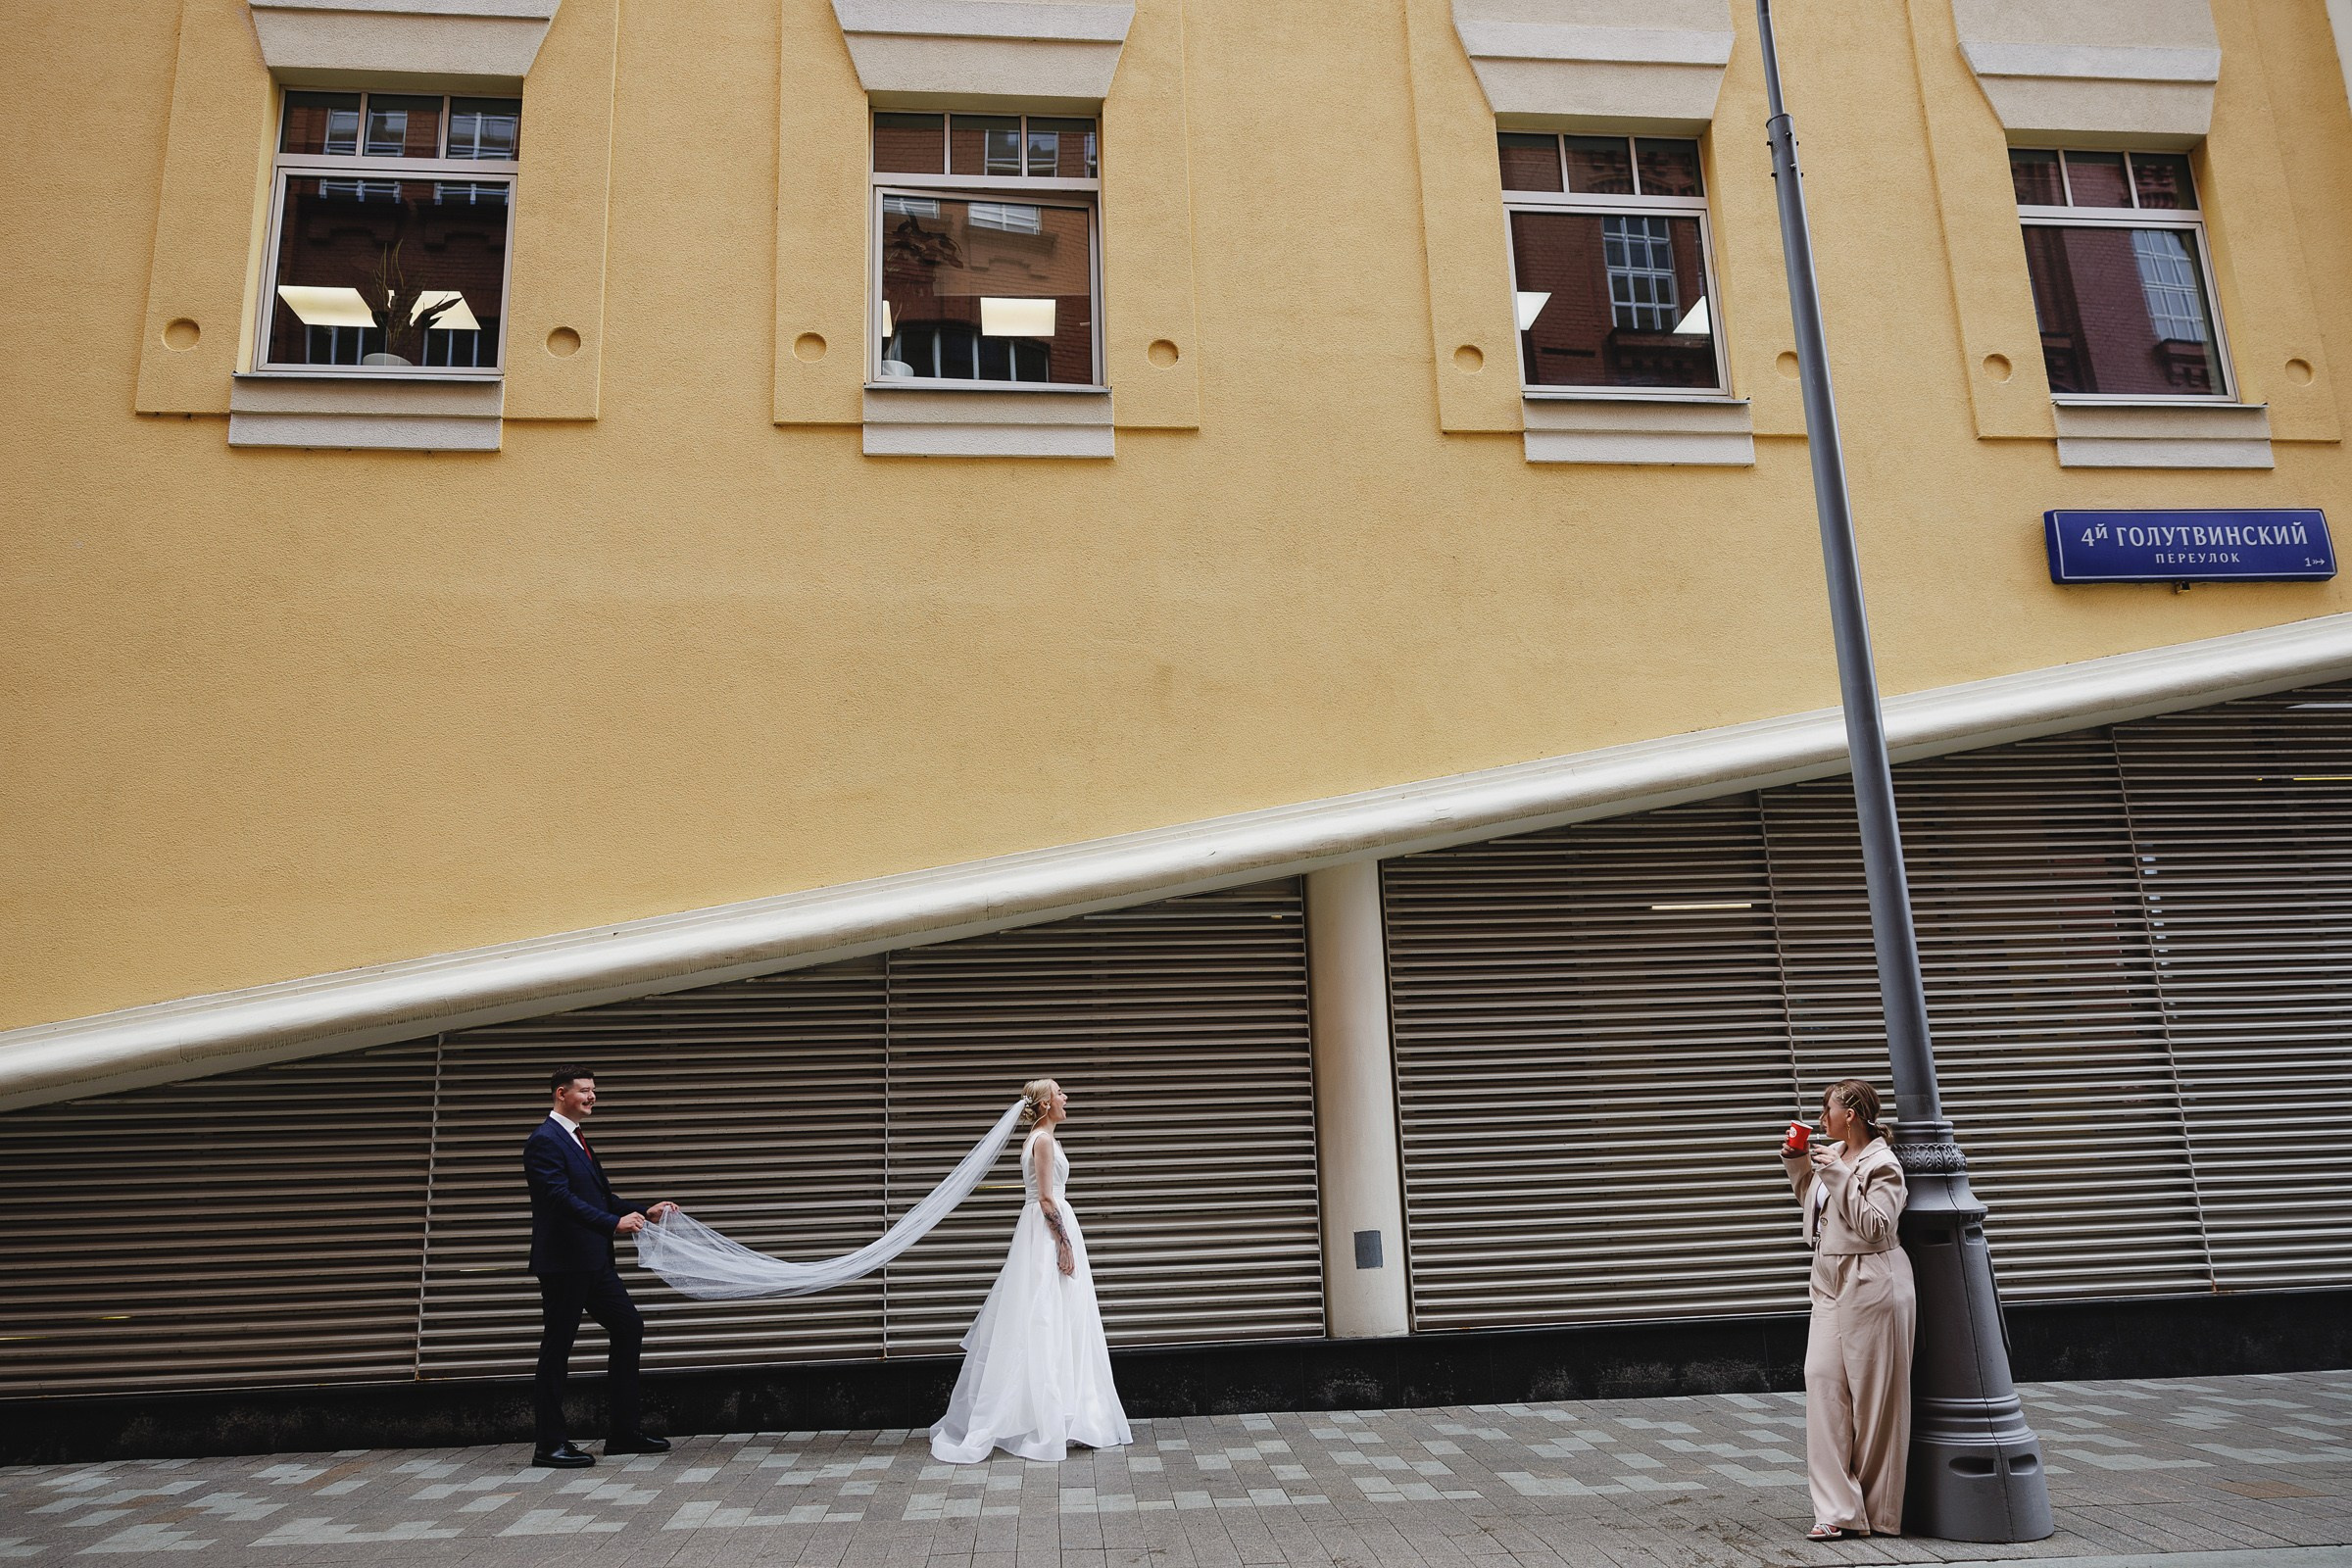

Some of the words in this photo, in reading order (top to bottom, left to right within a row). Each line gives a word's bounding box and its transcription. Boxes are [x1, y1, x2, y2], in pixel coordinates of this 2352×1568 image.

[2116, 521, 2309, 547] ГОЛУТВИНСКИЙ
[2155, 553, 2240, 564] ПЕРЕУЛОК
[2304, 557, 2312, 567] 1
